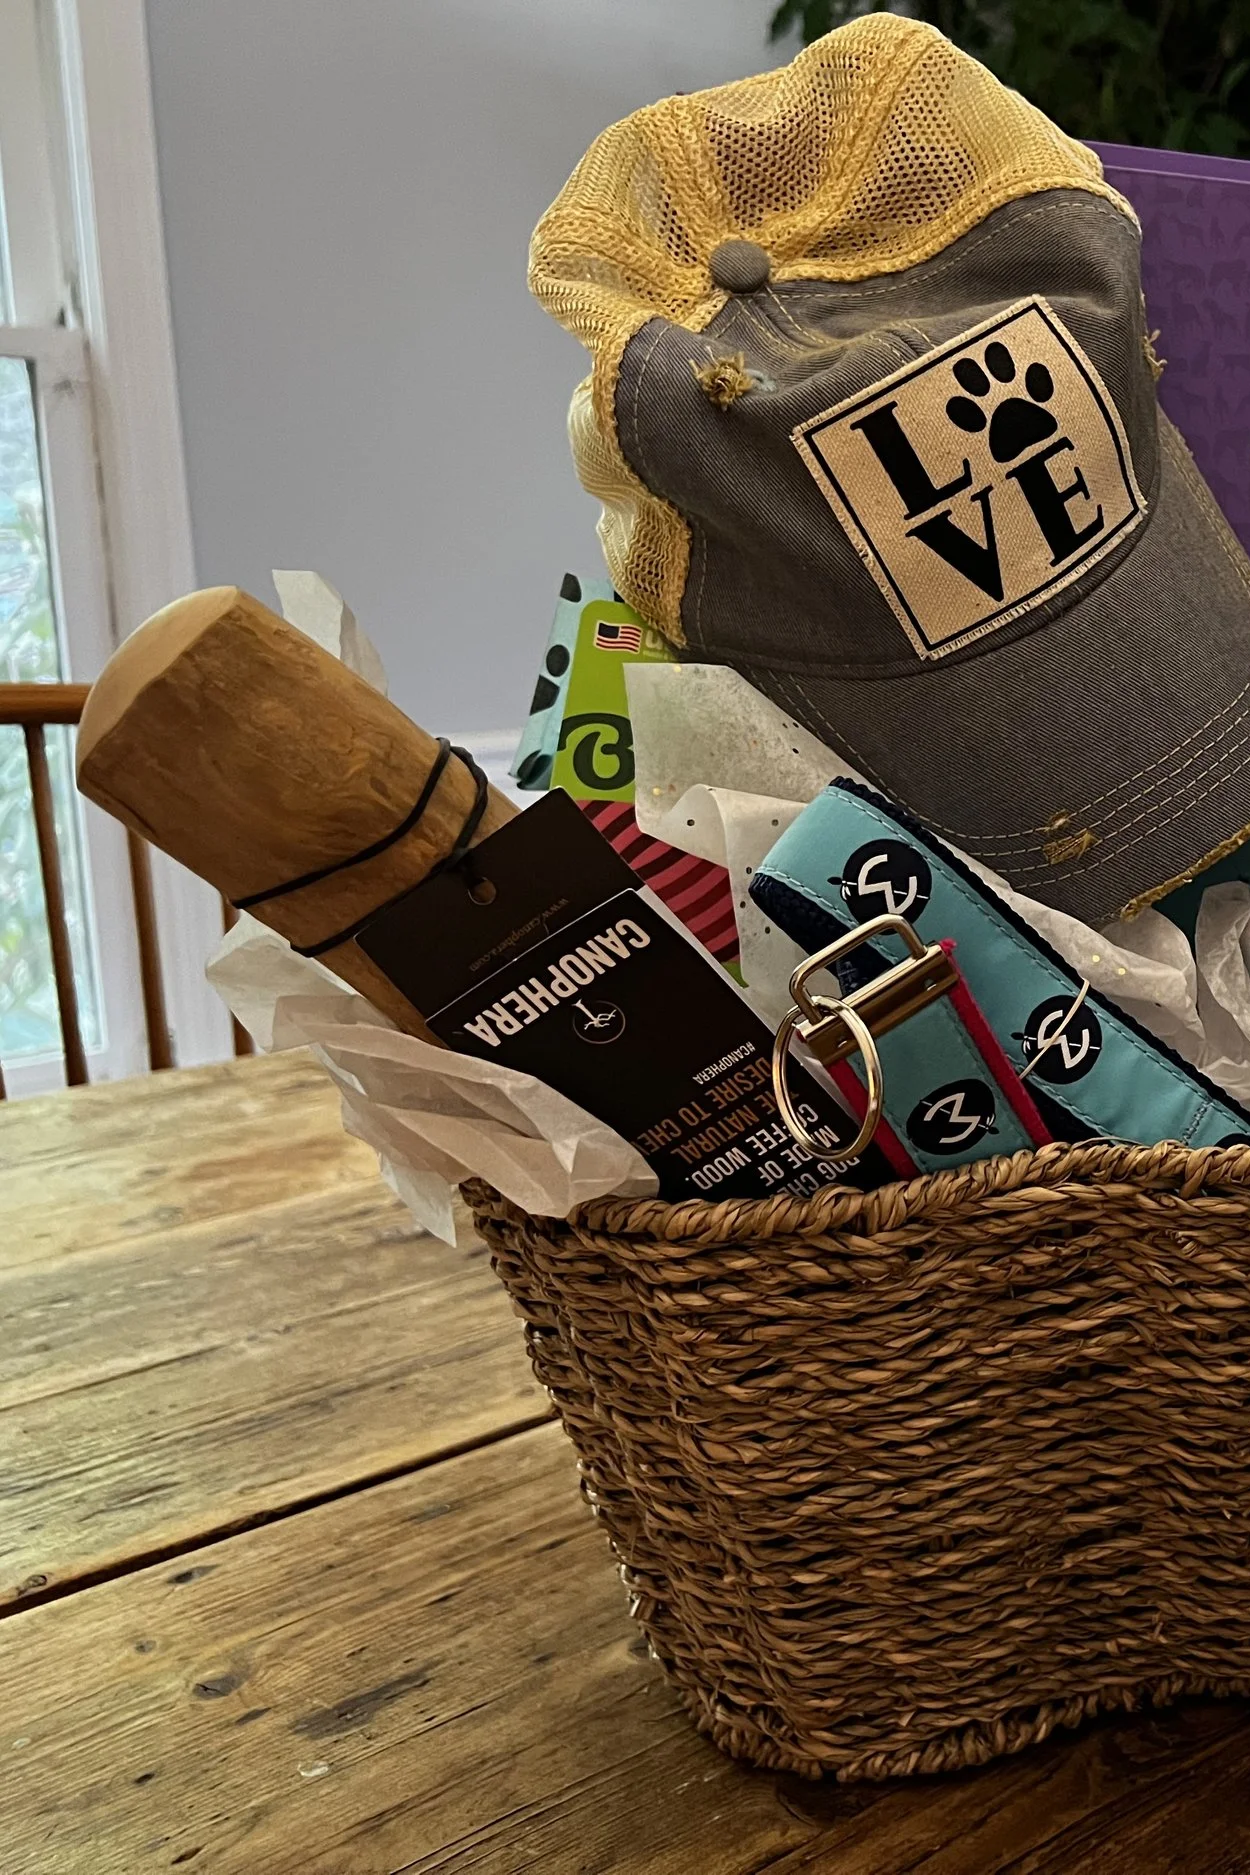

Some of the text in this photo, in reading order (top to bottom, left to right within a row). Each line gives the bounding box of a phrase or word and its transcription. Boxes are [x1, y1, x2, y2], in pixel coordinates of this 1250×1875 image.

[462, 917, 651, 1047] CANOPHERA
[692, 1041, 756, 1085] #CANOPHERA
[670, 1105, 760, 1165] NATURAL
[678, 1101, 712, 1127] TO
[685, 1103, 819, 1191] CFEE WOOD.
[757, 1125, 840, 1187] MDE OF
